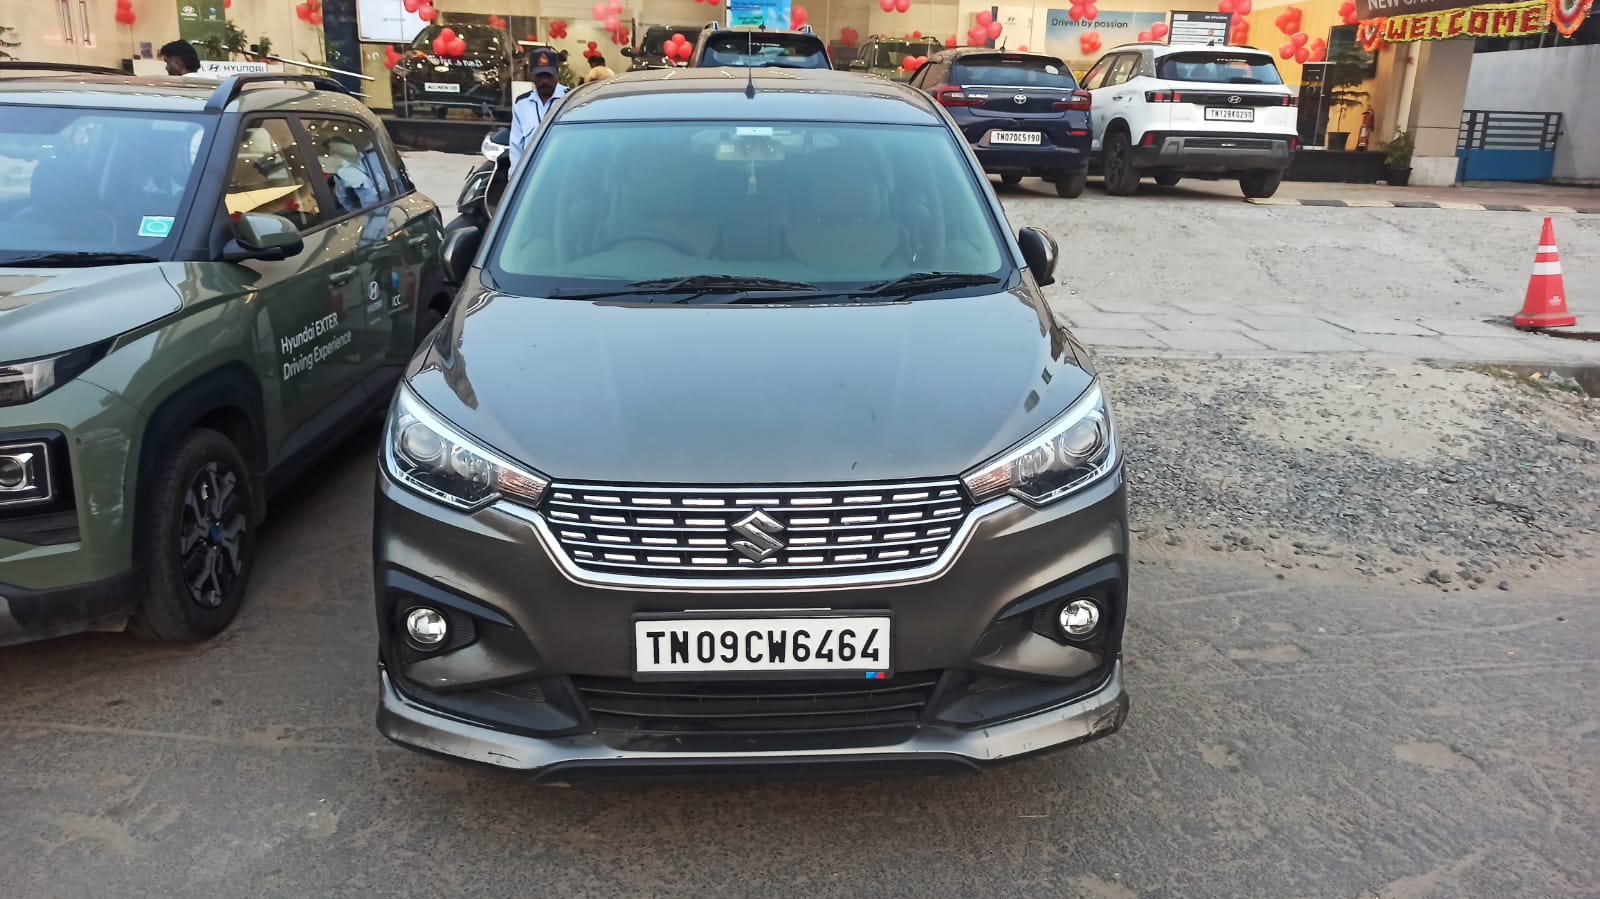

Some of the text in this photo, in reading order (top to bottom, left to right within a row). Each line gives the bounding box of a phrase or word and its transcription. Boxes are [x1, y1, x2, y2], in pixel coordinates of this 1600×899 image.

[1051, 18, 1128, 29] Driven by passion
[1386, 8, 1541, 40] WELCOME
[223, 64, 264, 73] HYUNDAI
[281, 312, 339, 354] Hyundai EXTER
[283, 331, 352, 380] Driving Experience
[646, 628, 880, 665] TN09CW6464
